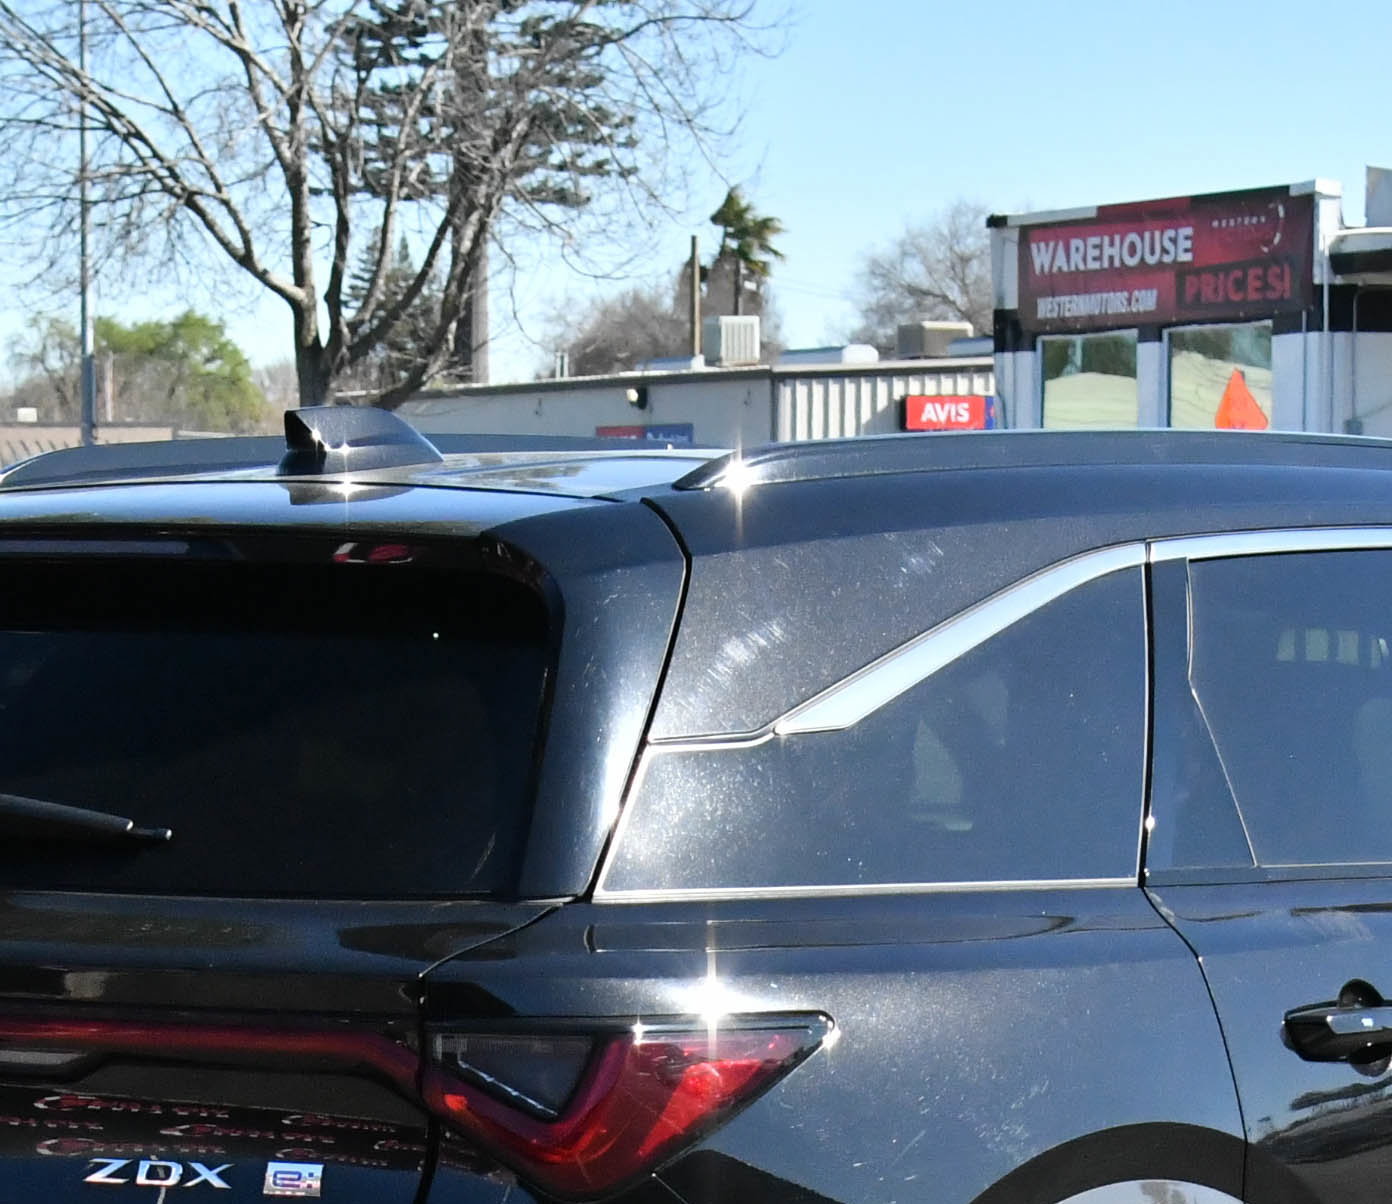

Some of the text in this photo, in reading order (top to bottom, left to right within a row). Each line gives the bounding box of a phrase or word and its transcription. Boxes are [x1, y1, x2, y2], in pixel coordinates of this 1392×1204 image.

[1030, 226, 1194, 276] WAREHOUSE
[1185, 263, 1292, 304] PRICES!
[1037, 288, 1157, 319] WESTERNMOTORS.COM
[920, 402, 970, 423] AVIS
[82, 1157, 236, 1189] ZDX
